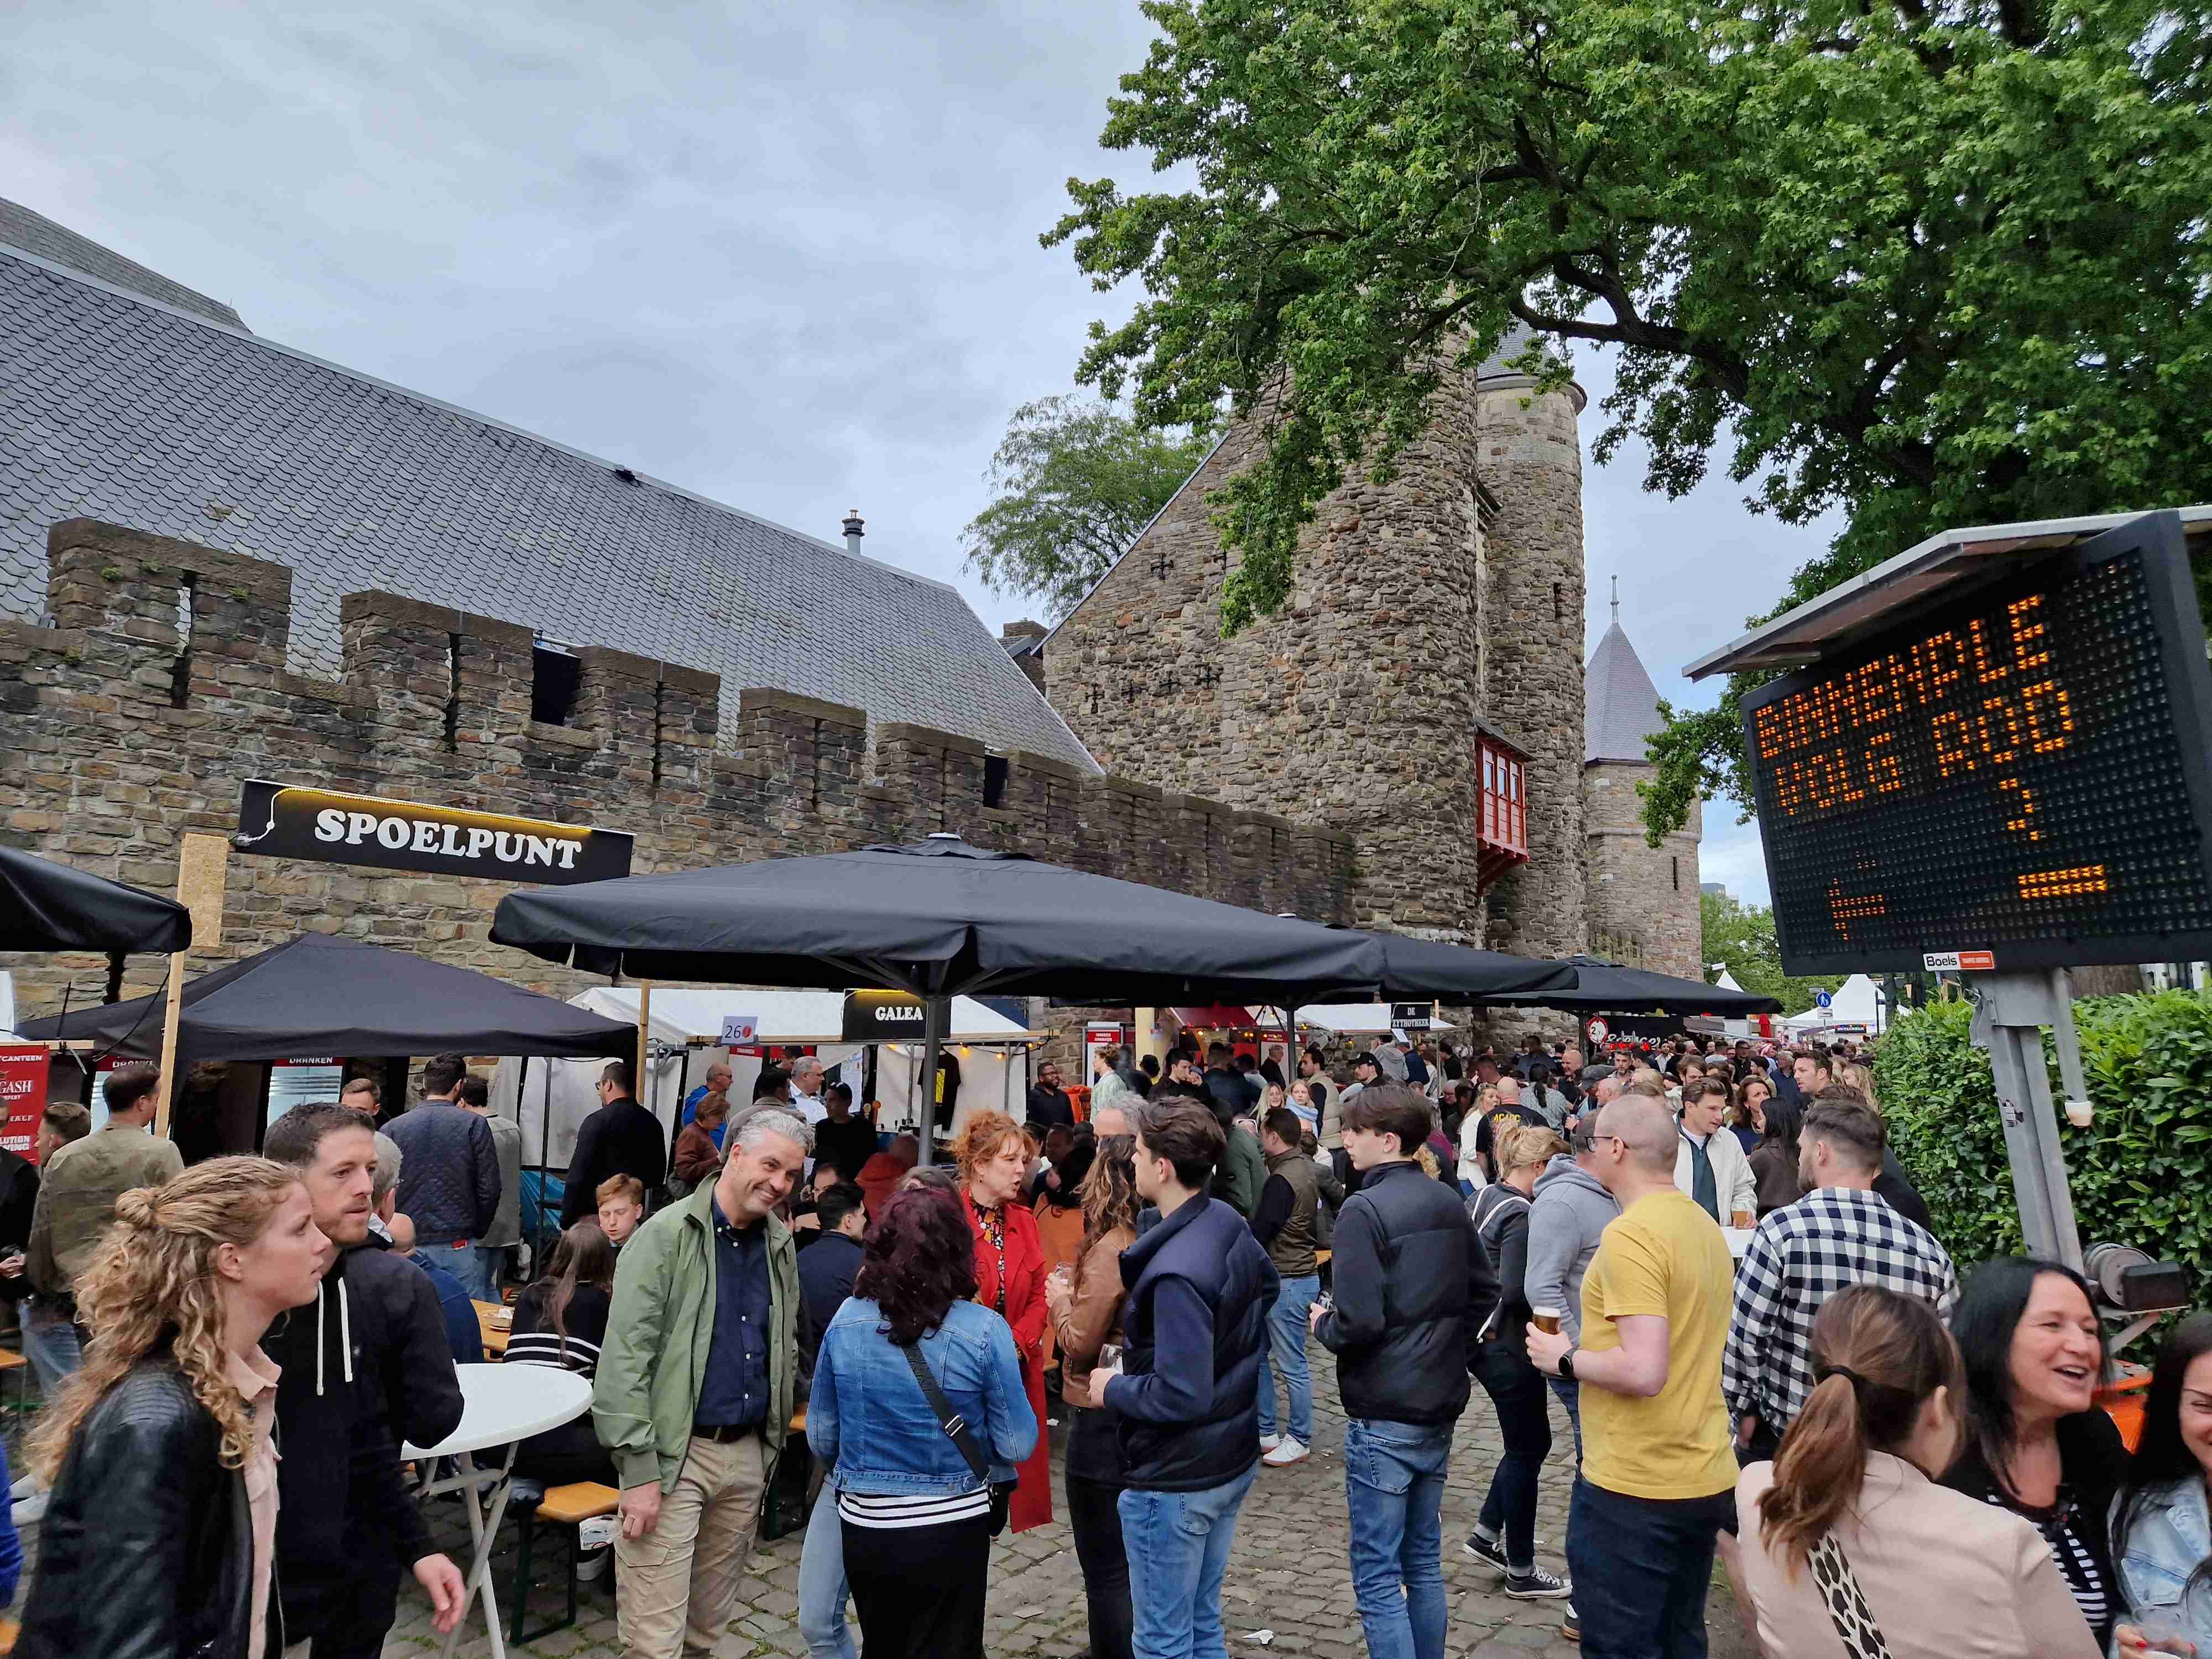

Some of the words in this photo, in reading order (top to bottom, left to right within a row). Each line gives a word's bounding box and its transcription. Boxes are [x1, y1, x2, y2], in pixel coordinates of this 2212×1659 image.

[314, 808, 582, 869] SPOELPUNT
[1926, 955, 1958, 967] Boels
[875, 1006, 924, 1021] GALEA
[1407, 1007, 1416, 1016] DE
